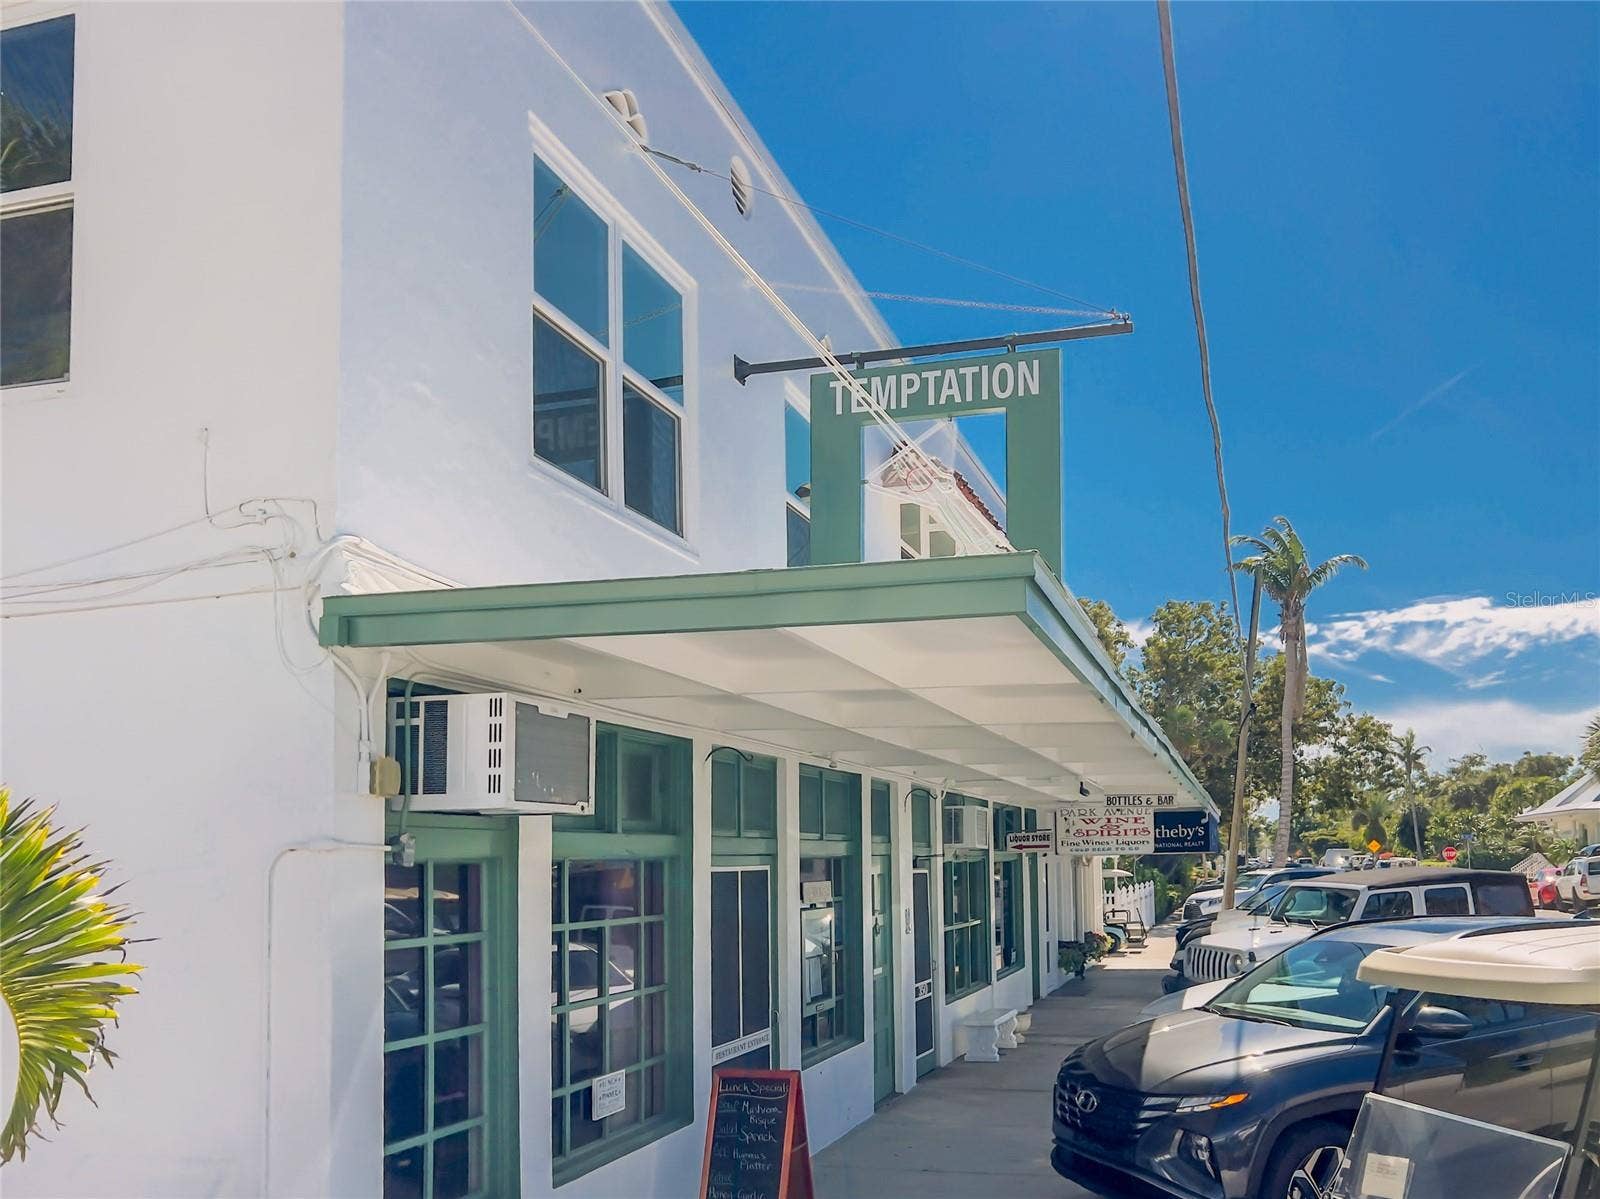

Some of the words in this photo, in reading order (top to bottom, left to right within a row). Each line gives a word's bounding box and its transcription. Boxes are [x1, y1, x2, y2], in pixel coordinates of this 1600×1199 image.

[829, 359, 1040, 415] TEMPTATION
[1106, 796, 1142, 806] BOTTLES
[1146, 797, 1153, 805] &
[1157, 796, 1174, 805] BAR
[1060, 808, 1097, 817] PARK
[1104, 808, 1151, 816] AVENUE
[1080, 816, 1145, 825] WINE
[1073, 827, 1151, 837] SPIRITS
[1009, 834, 1031, 843] LIQUOR
[1031, 833, 1050, 842] STORE
[719, 1080, 750, 1094] Lunch
